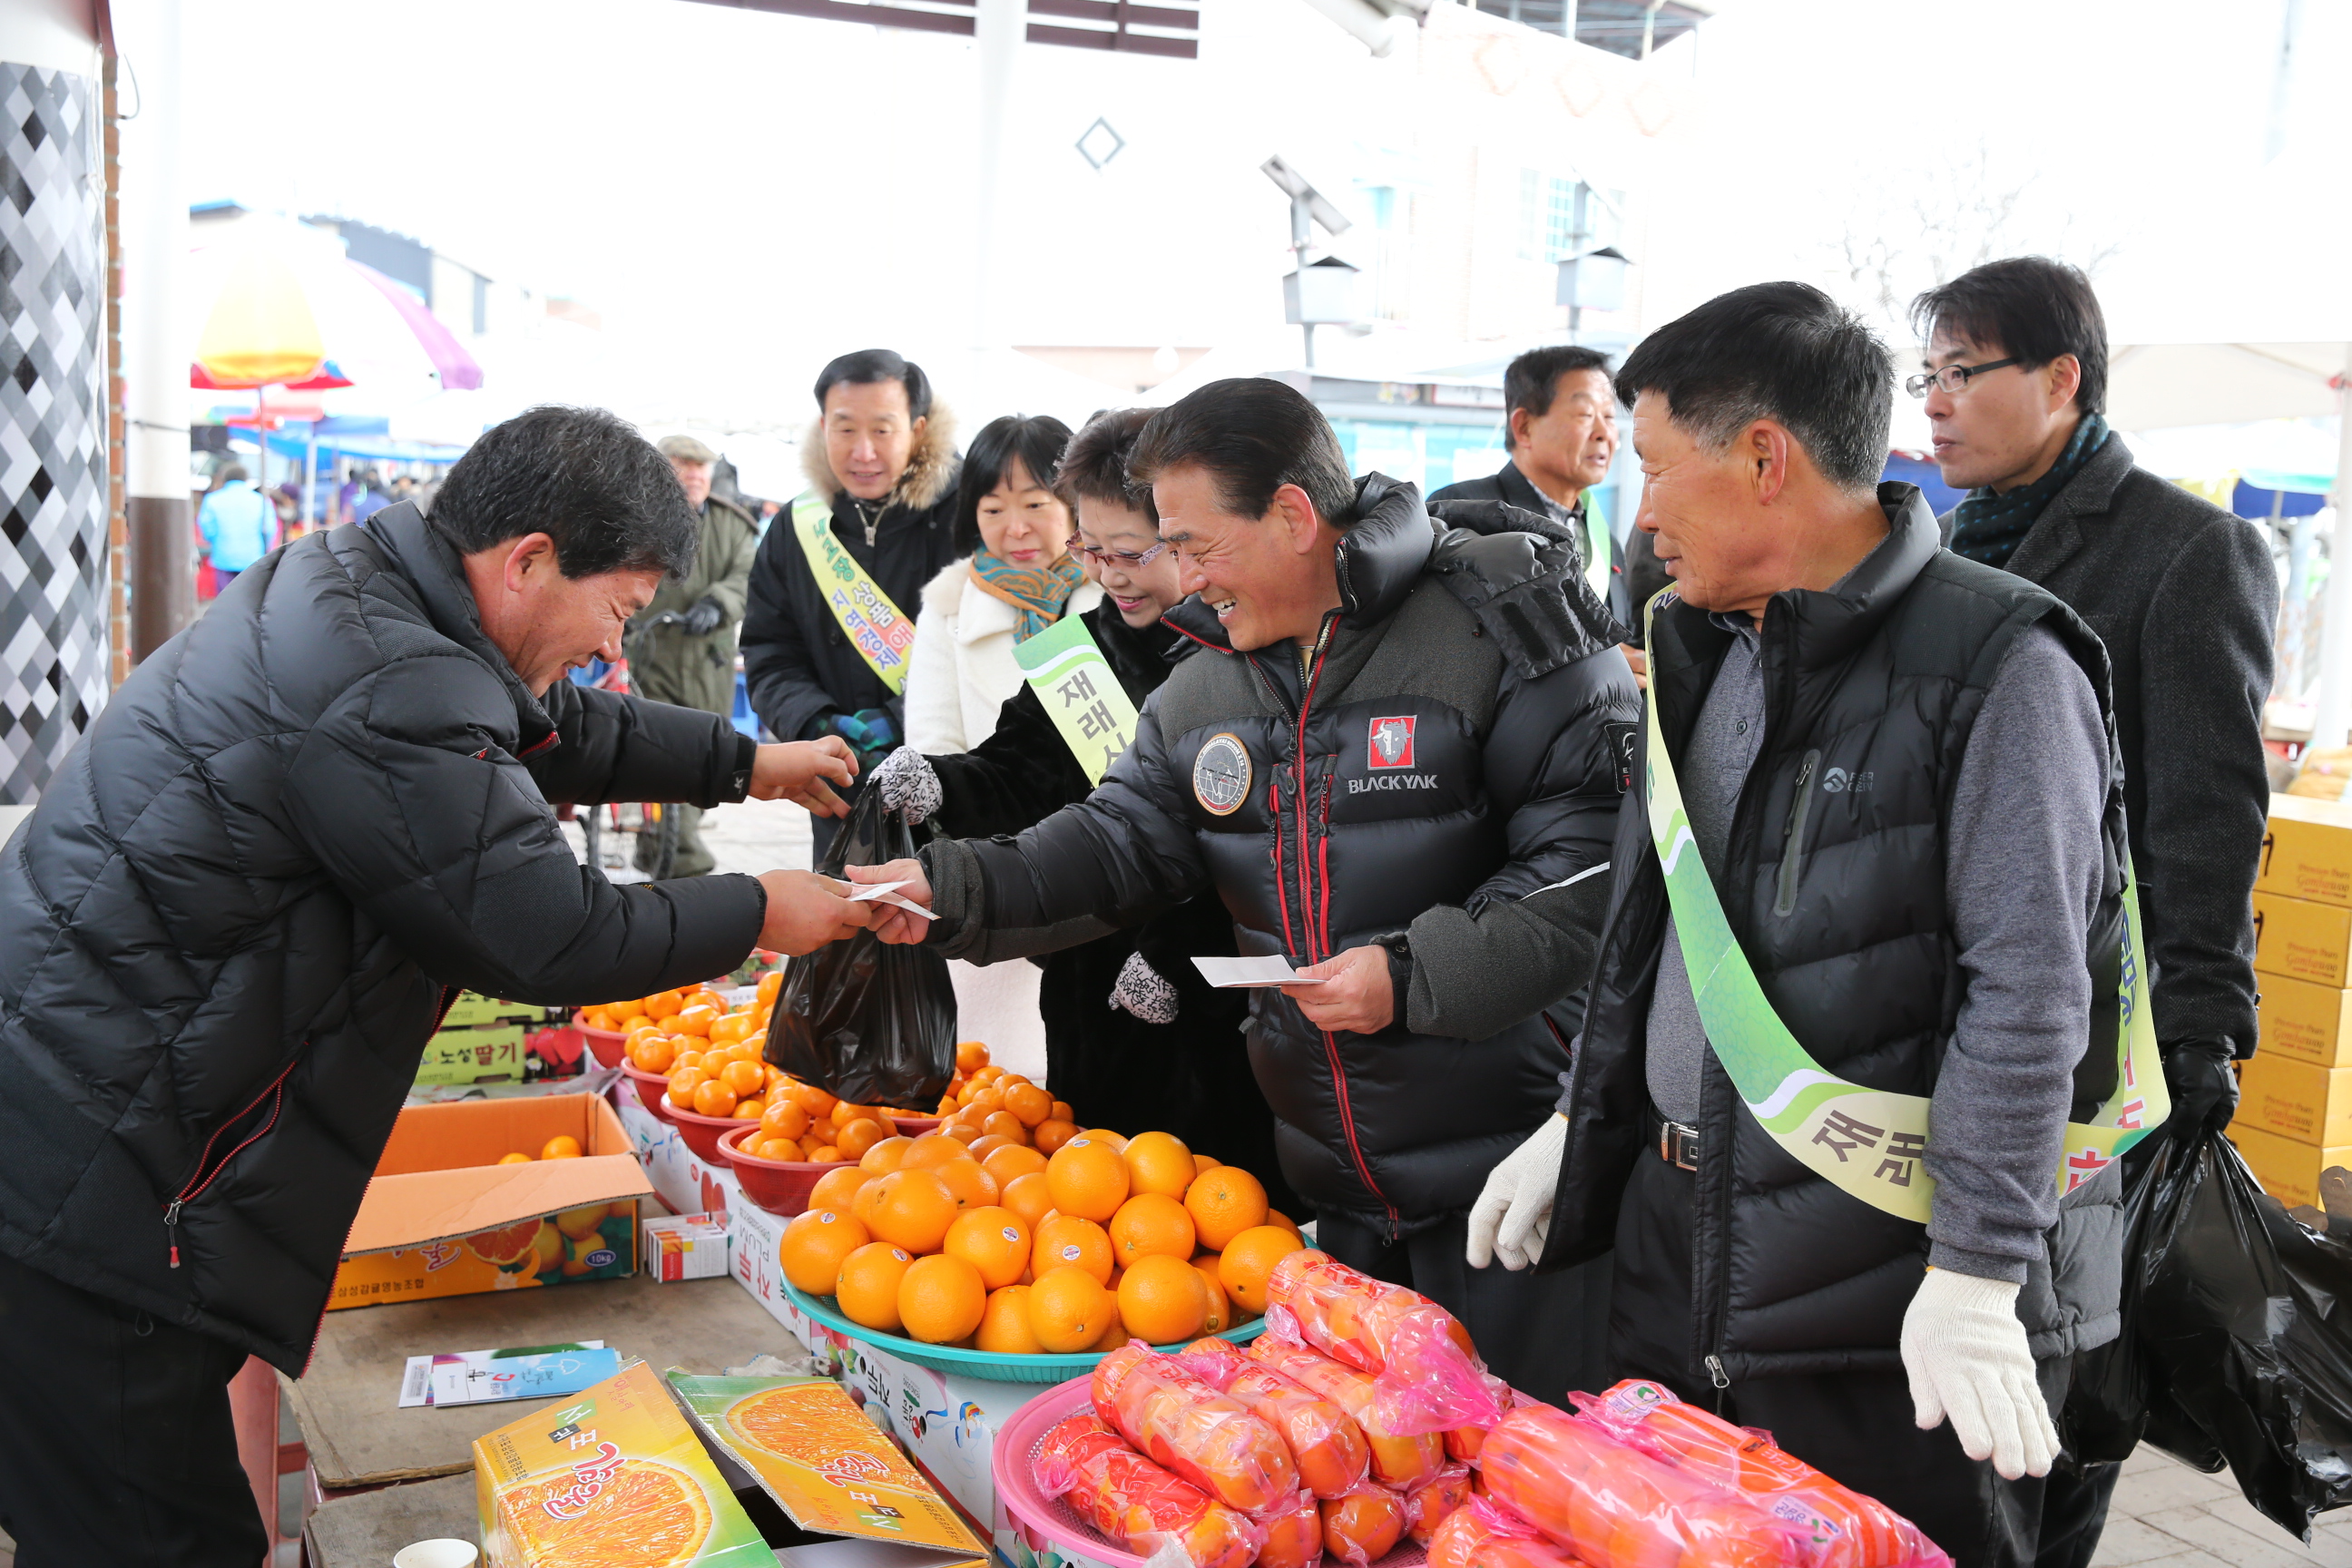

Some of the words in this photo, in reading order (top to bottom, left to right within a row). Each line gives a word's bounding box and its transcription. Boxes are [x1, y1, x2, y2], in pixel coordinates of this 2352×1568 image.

[853, 581, 895, 629] 상품
[830, 588, 902, 671] 지역경제
[1348, 776, 1402, 795] BLACK
[1404, 774, 1438, 790] YAK
[591, 1253, 612, 1264] 10kg
[740, 1224, 769, 1262] PLUM
[739, 1243, 771, 1301] 자두
[867, 1365, 891, 1408] 자두
[548, 1403, 597, 1451] 서귀포
[542, 1441, 628, 1521] 감귤
[812, 1450, 891, 1488] 감귤
[848, 1490, 904, 1532] 서귀포
